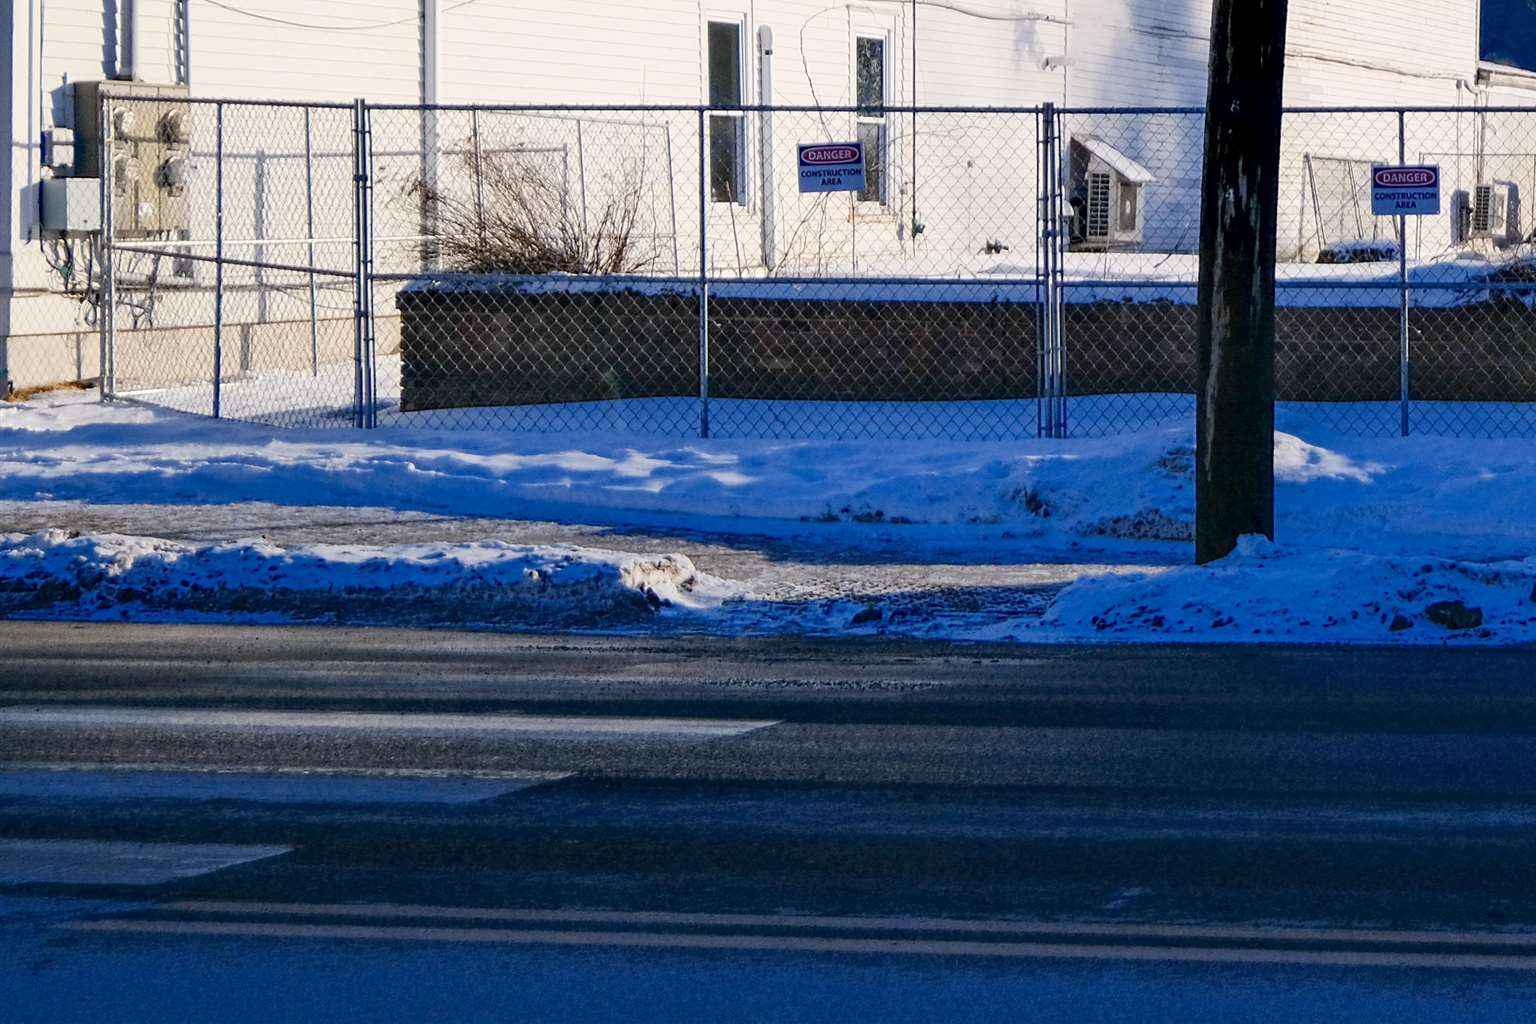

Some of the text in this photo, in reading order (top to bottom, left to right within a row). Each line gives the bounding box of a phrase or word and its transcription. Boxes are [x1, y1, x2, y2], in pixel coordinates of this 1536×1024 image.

[808, 150, 852, 161] DANGER
[801, 168, 862, 178] CONSTRUCTION
[1382, 173, 1428, 182] DANGER
[821, 177, 842, 186] AREA
[1374, 192, 1437, 201] CONSTRUCTION
[1395, 201, 1417, 209] AREA
